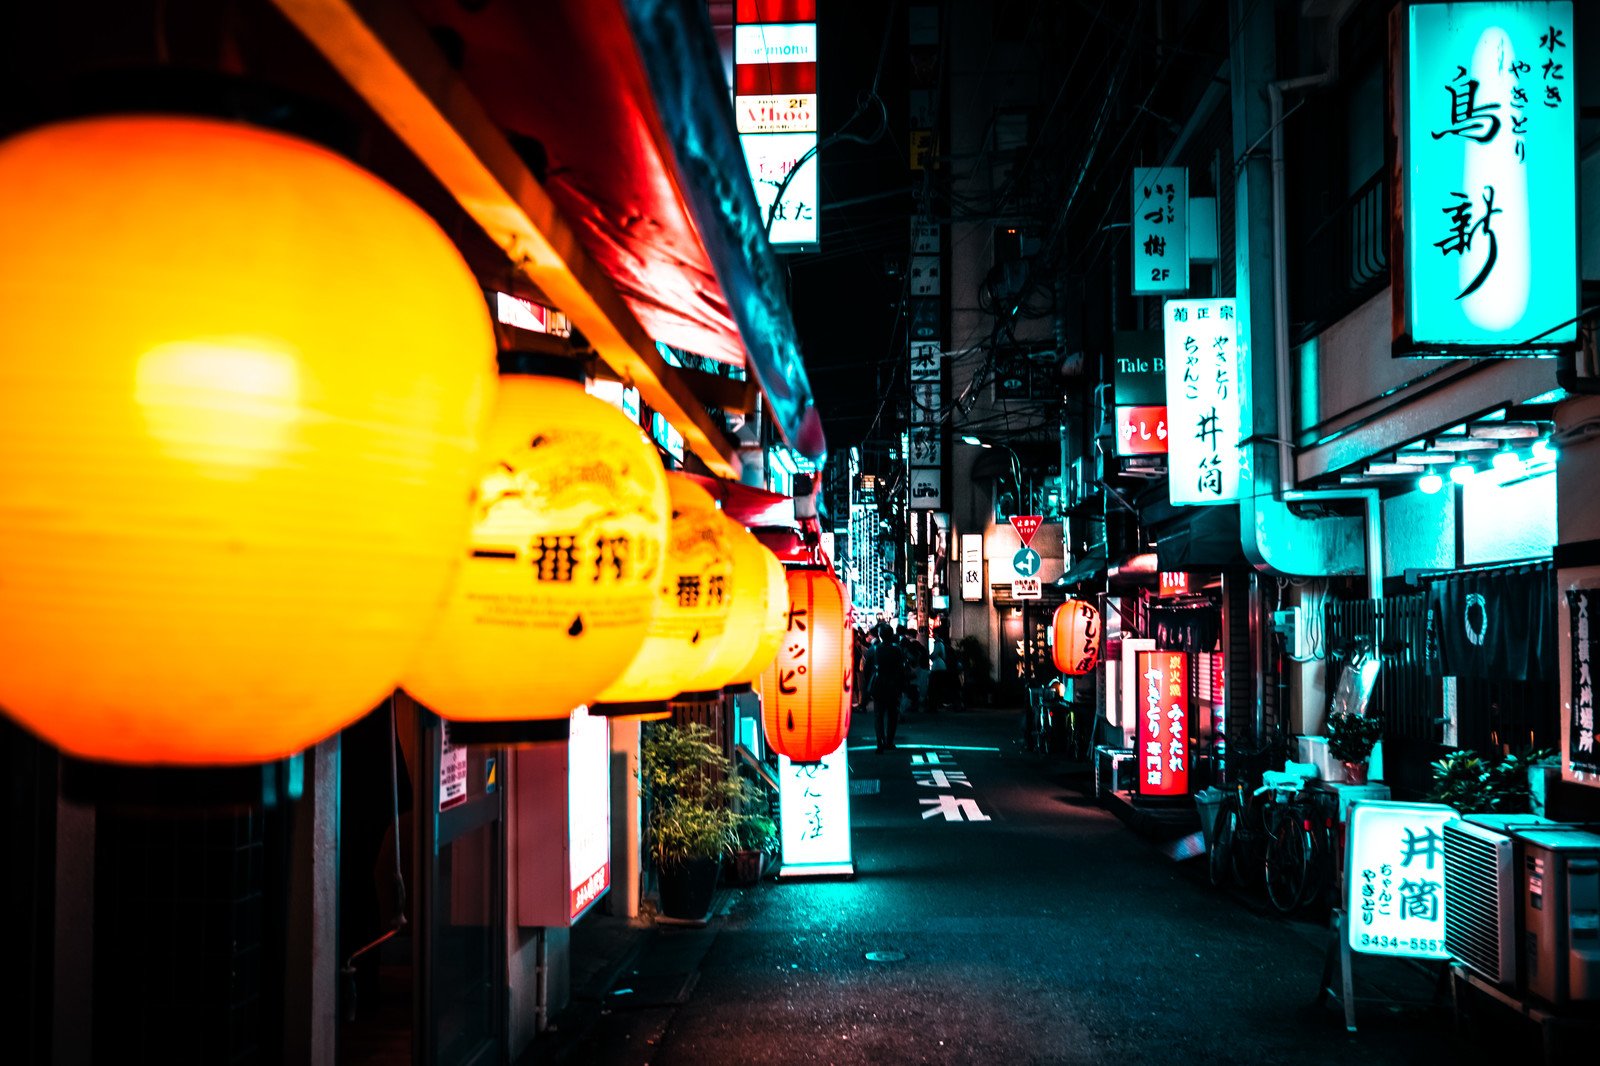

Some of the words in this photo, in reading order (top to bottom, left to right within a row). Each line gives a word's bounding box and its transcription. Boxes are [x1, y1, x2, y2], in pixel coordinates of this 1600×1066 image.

[1539, 26, 1566, 108] 水たき
[789, 98, 807, 109] 2F
[1509, 60, 1531, 164] やきとり
[1431, 66, 1503, 300] 鳥新
[1151, 268, 1170, 281] 2F
[1174, 305, 1233, 322] 菊正宗
[1117, 358, 1148, 373] Tale
[1153, 357, 1166, 372] B
[1184, 336, 1199, 400] ちゃんこ
[1213, 336, 1229, 400] やきとり
[1195, 406, 1223, 495] 井筒
[779, 602, 807, 731] ホッピー
[1167, 703, 1184, 772] みそたれ
[1361, 869, 1376, 926] やきとり
[1379, 863, 1393, 916] ちゃんこ
[1398, 826, 1445, 922] 井筒
